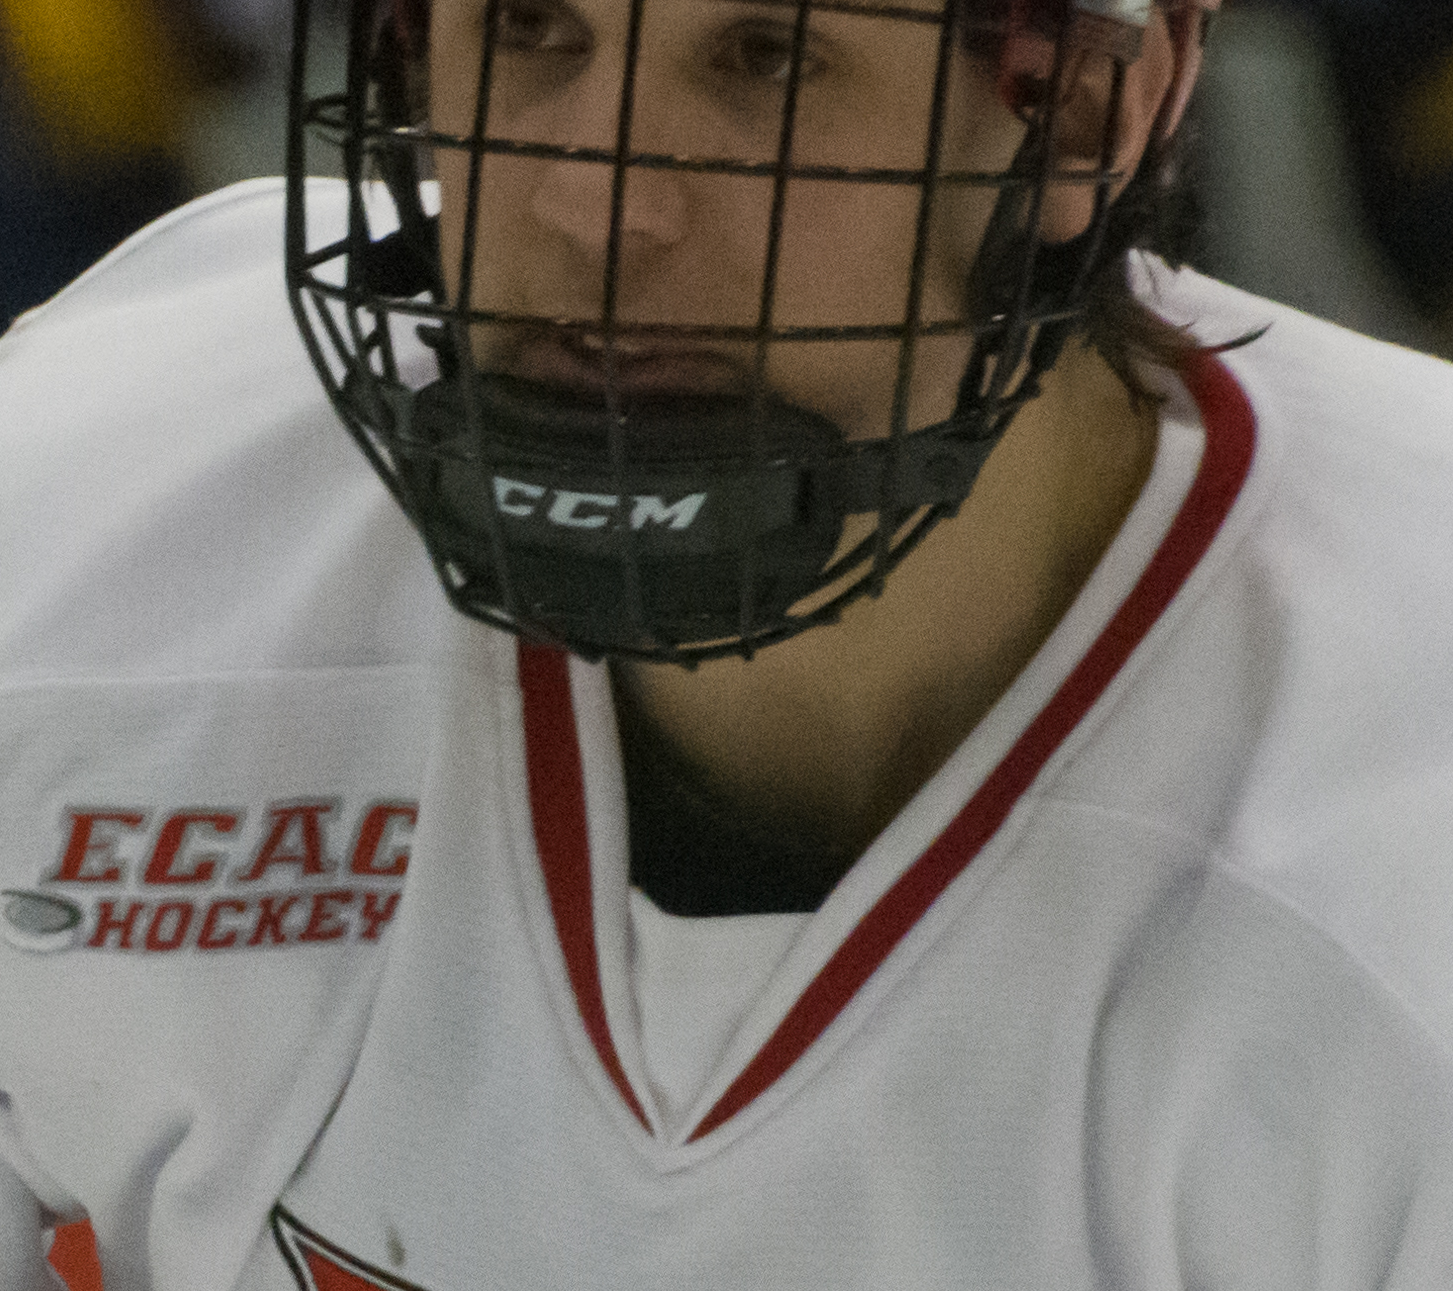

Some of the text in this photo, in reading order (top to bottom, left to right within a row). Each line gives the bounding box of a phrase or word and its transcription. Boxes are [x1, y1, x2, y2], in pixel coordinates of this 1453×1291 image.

[493, 475, 708, 531] CCM
[40, 797, 420, 886] ECAC
[85, 891, 402, 953] HOCKEY
